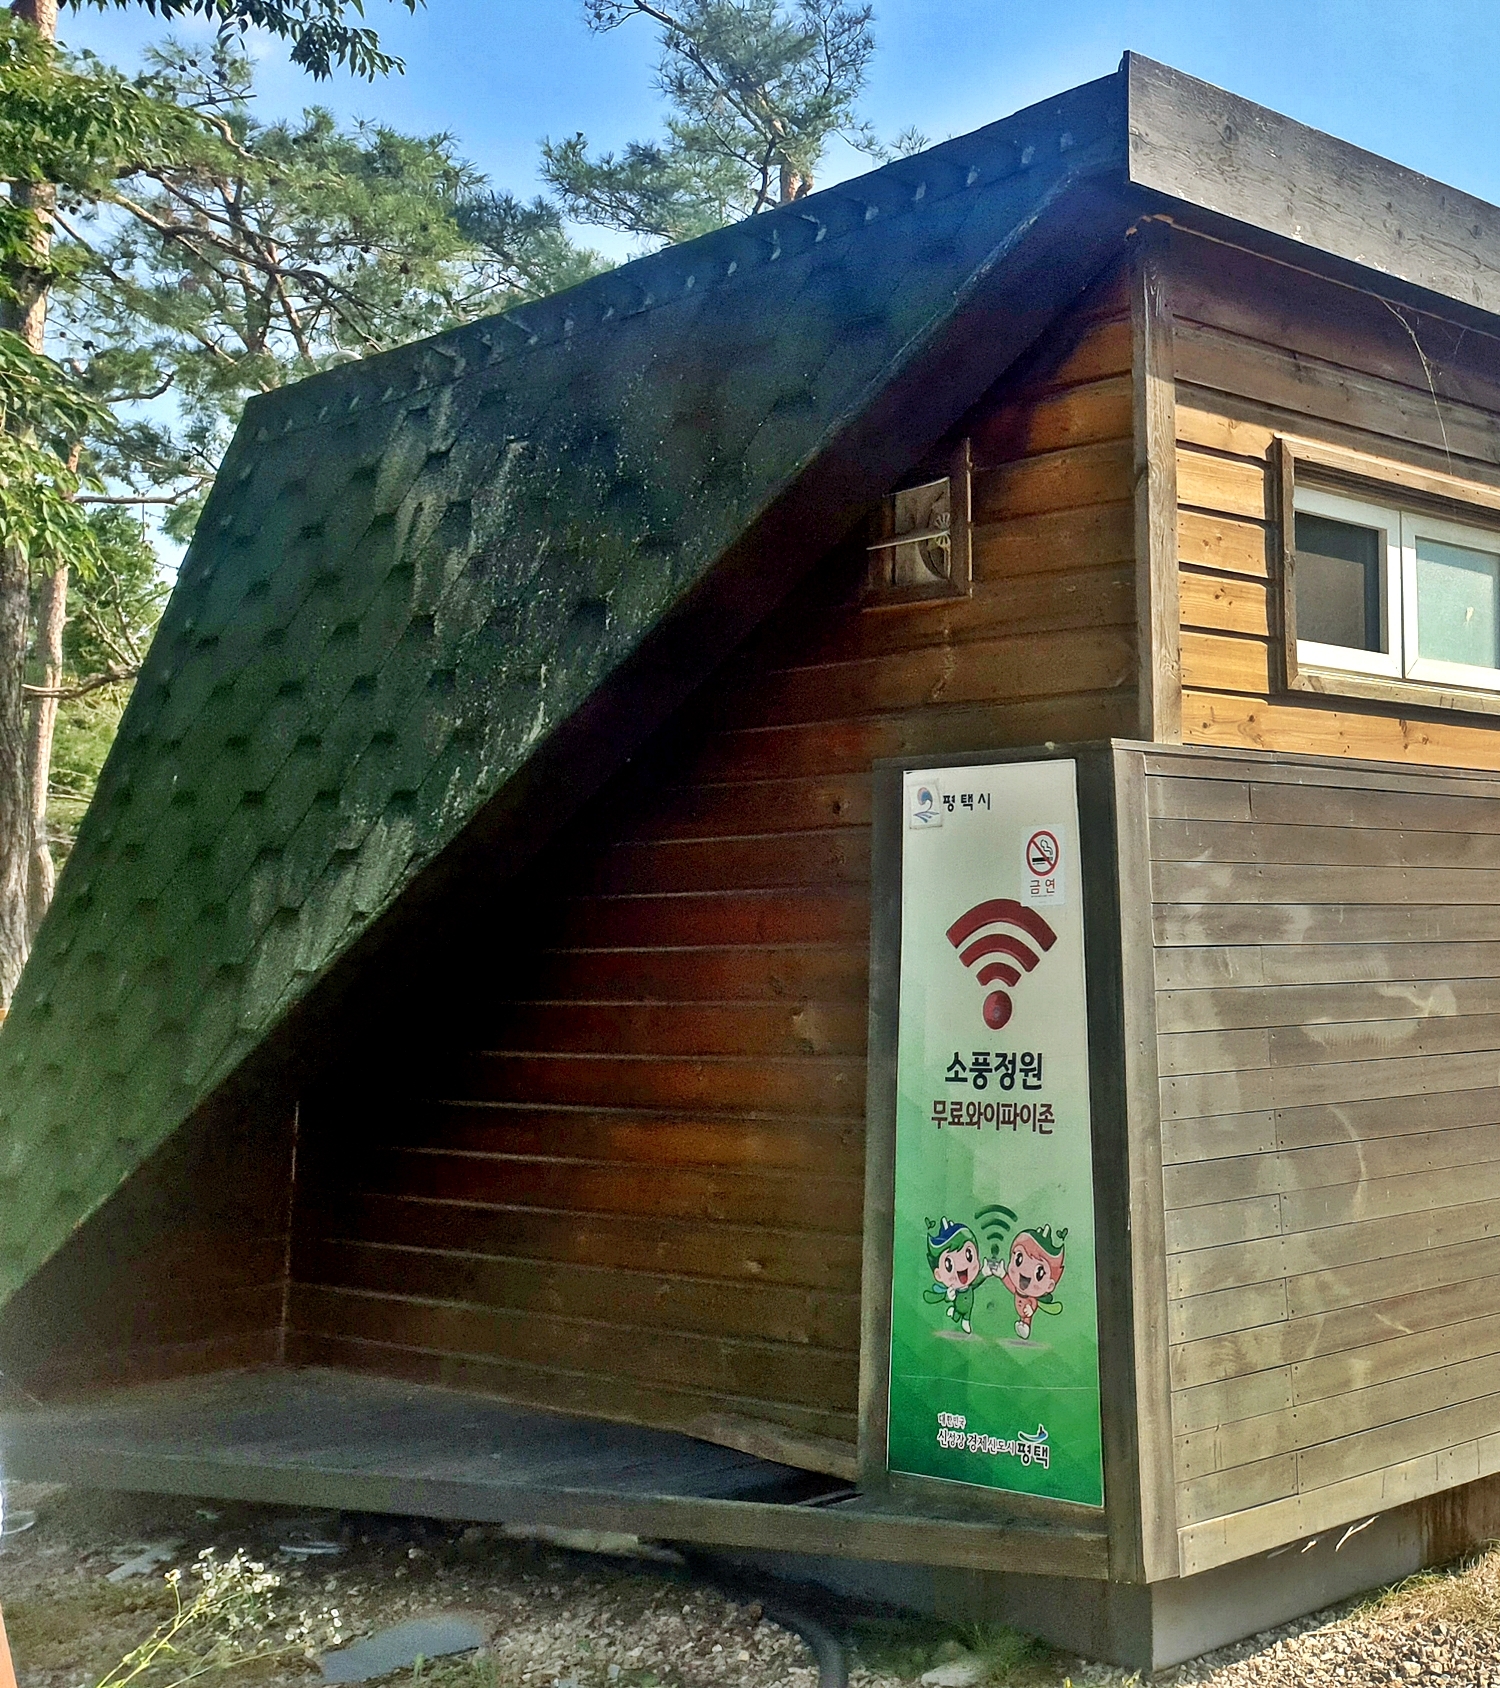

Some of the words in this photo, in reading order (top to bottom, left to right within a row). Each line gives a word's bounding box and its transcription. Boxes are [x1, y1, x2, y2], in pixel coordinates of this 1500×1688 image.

[943, 793, 991, 812] 평택시
[1030, 879, 1055, 894] 금연
[945, 1052, 1043, 1090] 소풍정원
[931, 1100, 1055, 1134] 무료와이파이존
[938, 1413, 966, 1429] 대한민국
[967, 1433, 1015, 1455] 경제신도시
[1017, 1441, 1049, 1468] 평택
